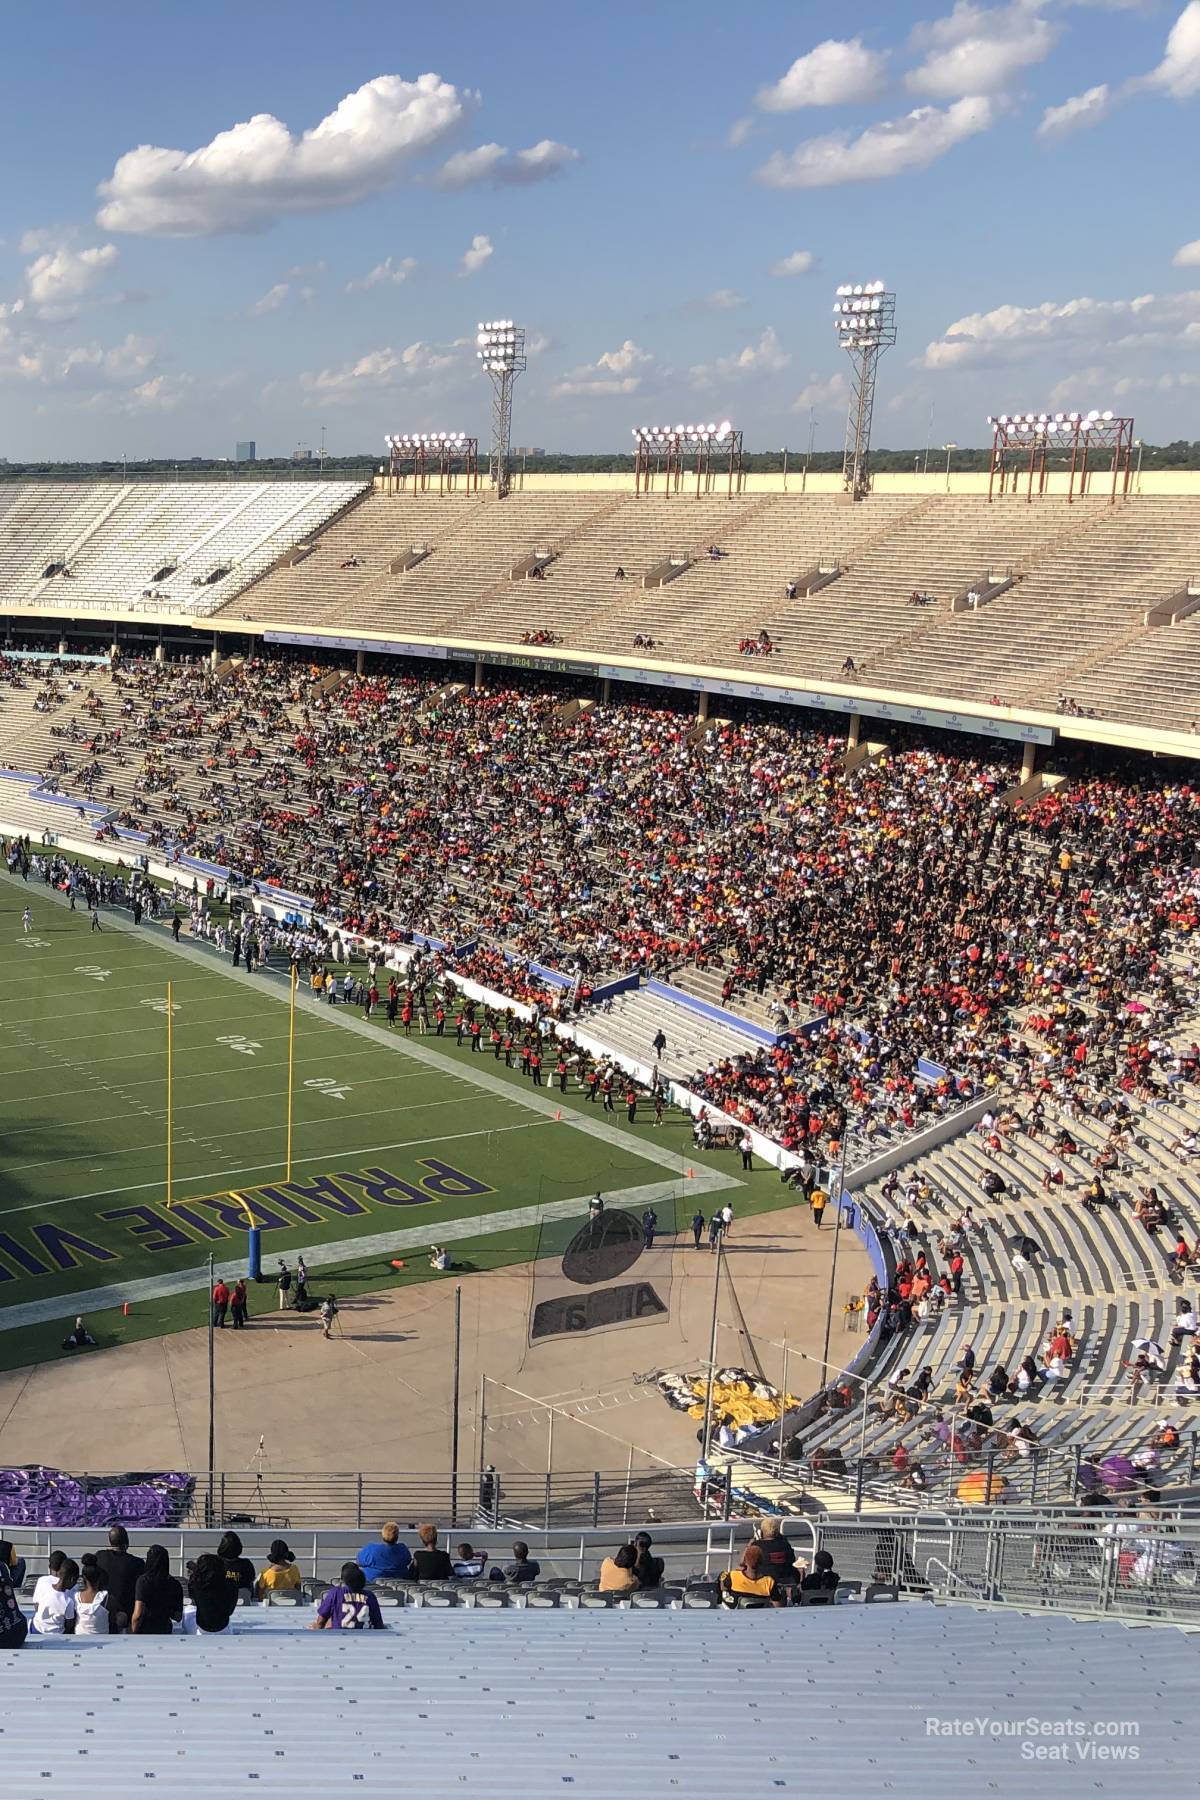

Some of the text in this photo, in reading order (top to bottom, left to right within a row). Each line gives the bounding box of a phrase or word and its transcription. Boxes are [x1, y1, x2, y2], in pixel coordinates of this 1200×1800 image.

[478, 653, 486, 662] 17
[512, 657, 530, 667] 10:04
[558, 662, 566, 671] 14
[215, 1035, 263, 1053] 20
[303, 1078, 353, 1097] 10
[101, 1157, 498, 1253] PRAIRIE
[341, 1603, 371, 1629] 24
